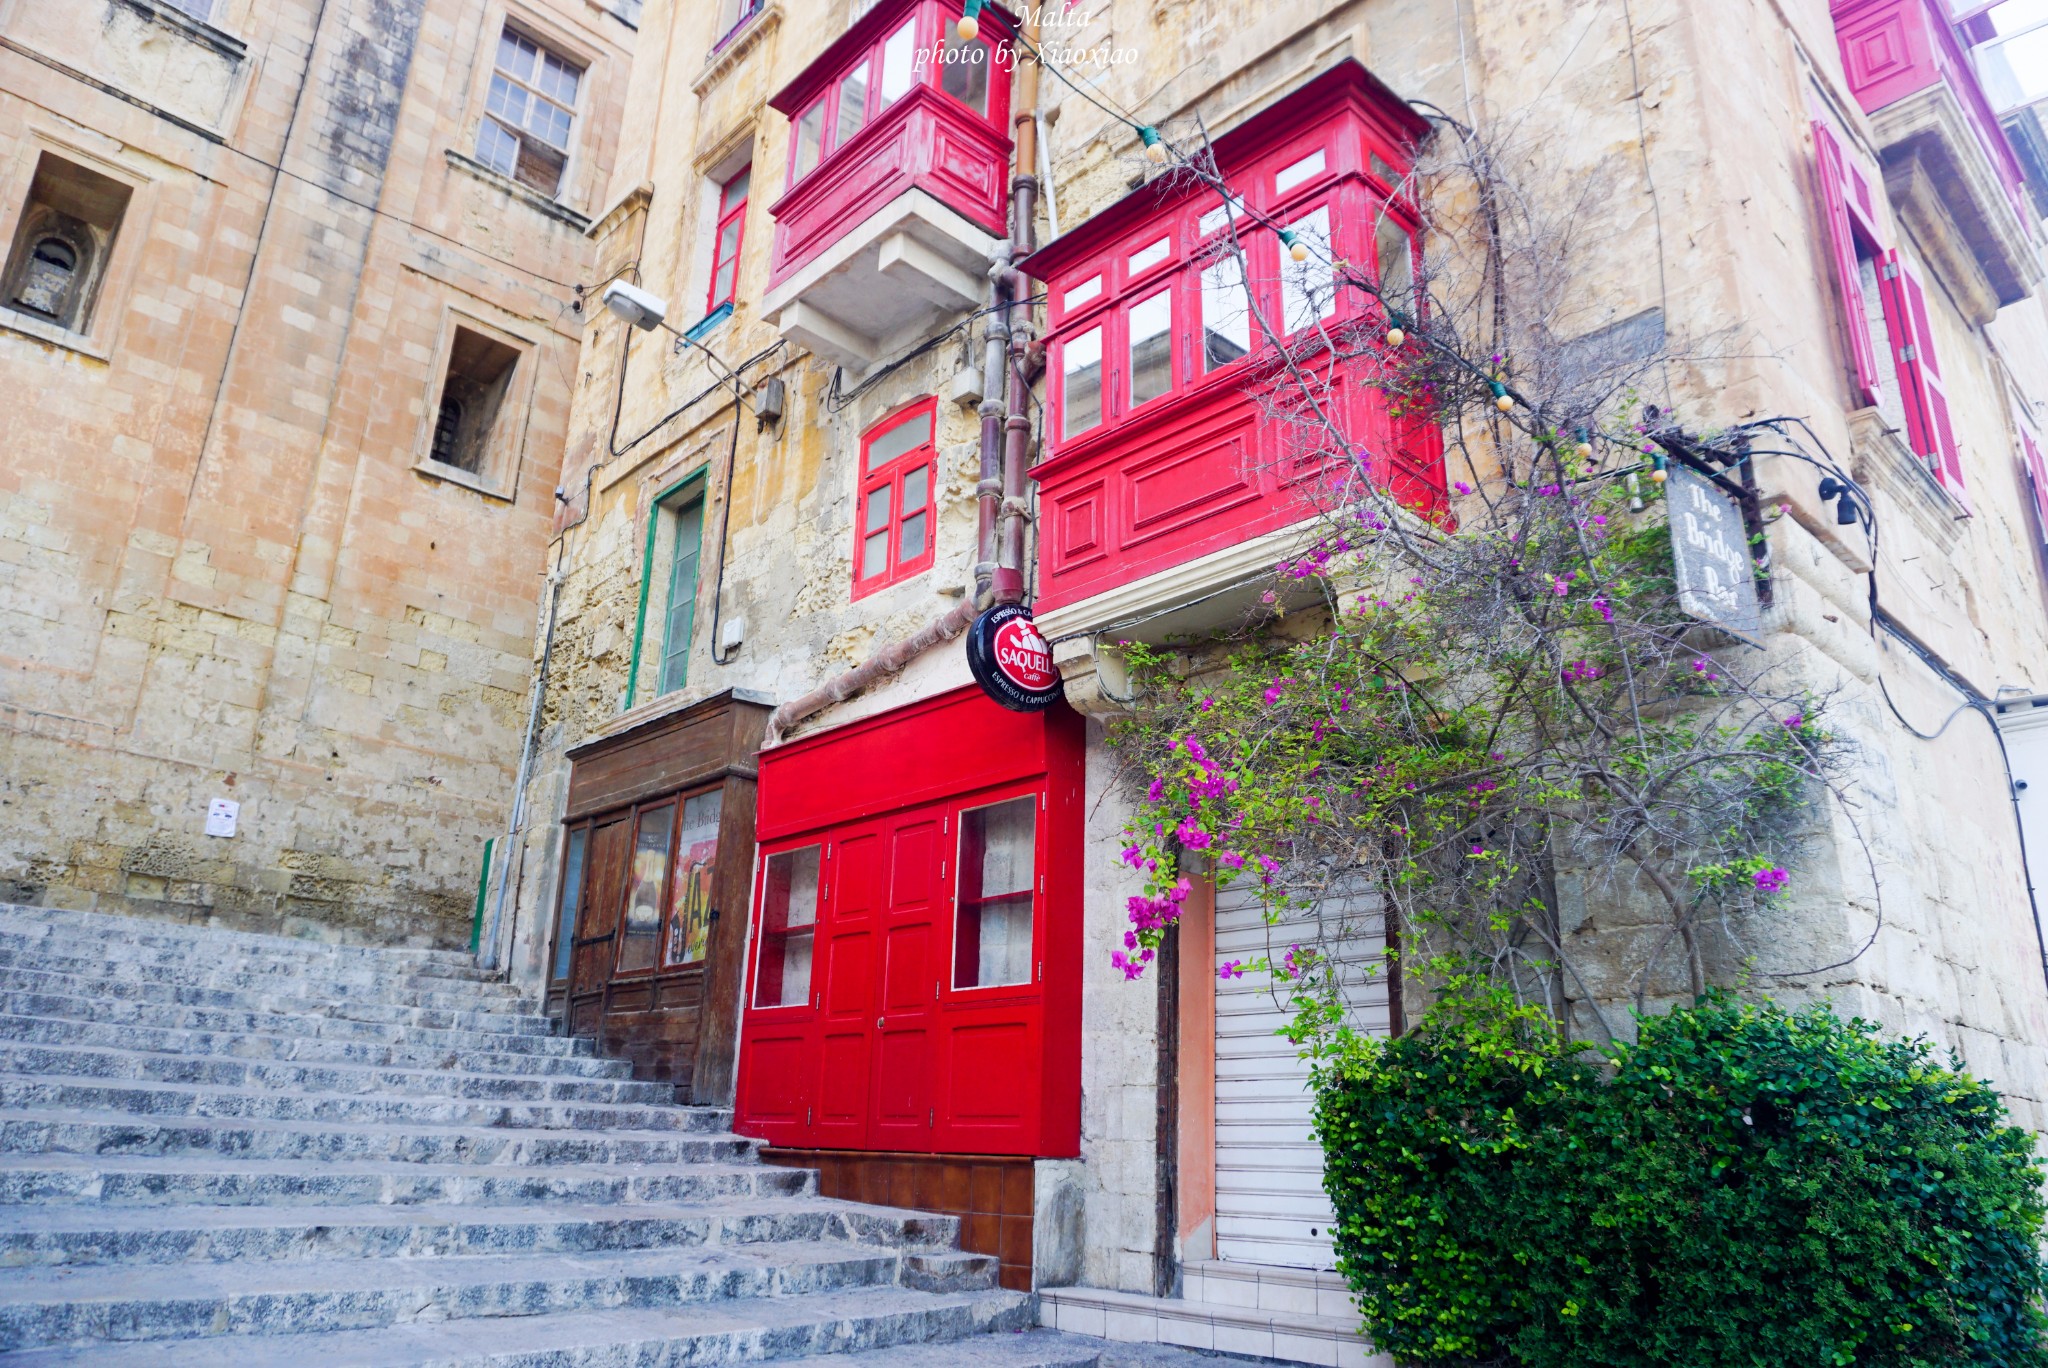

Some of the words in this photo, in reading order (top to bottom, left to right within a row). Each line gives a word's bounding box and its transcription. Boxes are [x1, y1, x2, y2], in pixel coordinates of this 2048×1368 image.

[1689, 484, 1722, 522] The
[1684, 511, 1745, 584] Bridge
[1001, 647, 1058, 677] SAQUELLA
[992, 671, 1019, 698] ESPRESSO
